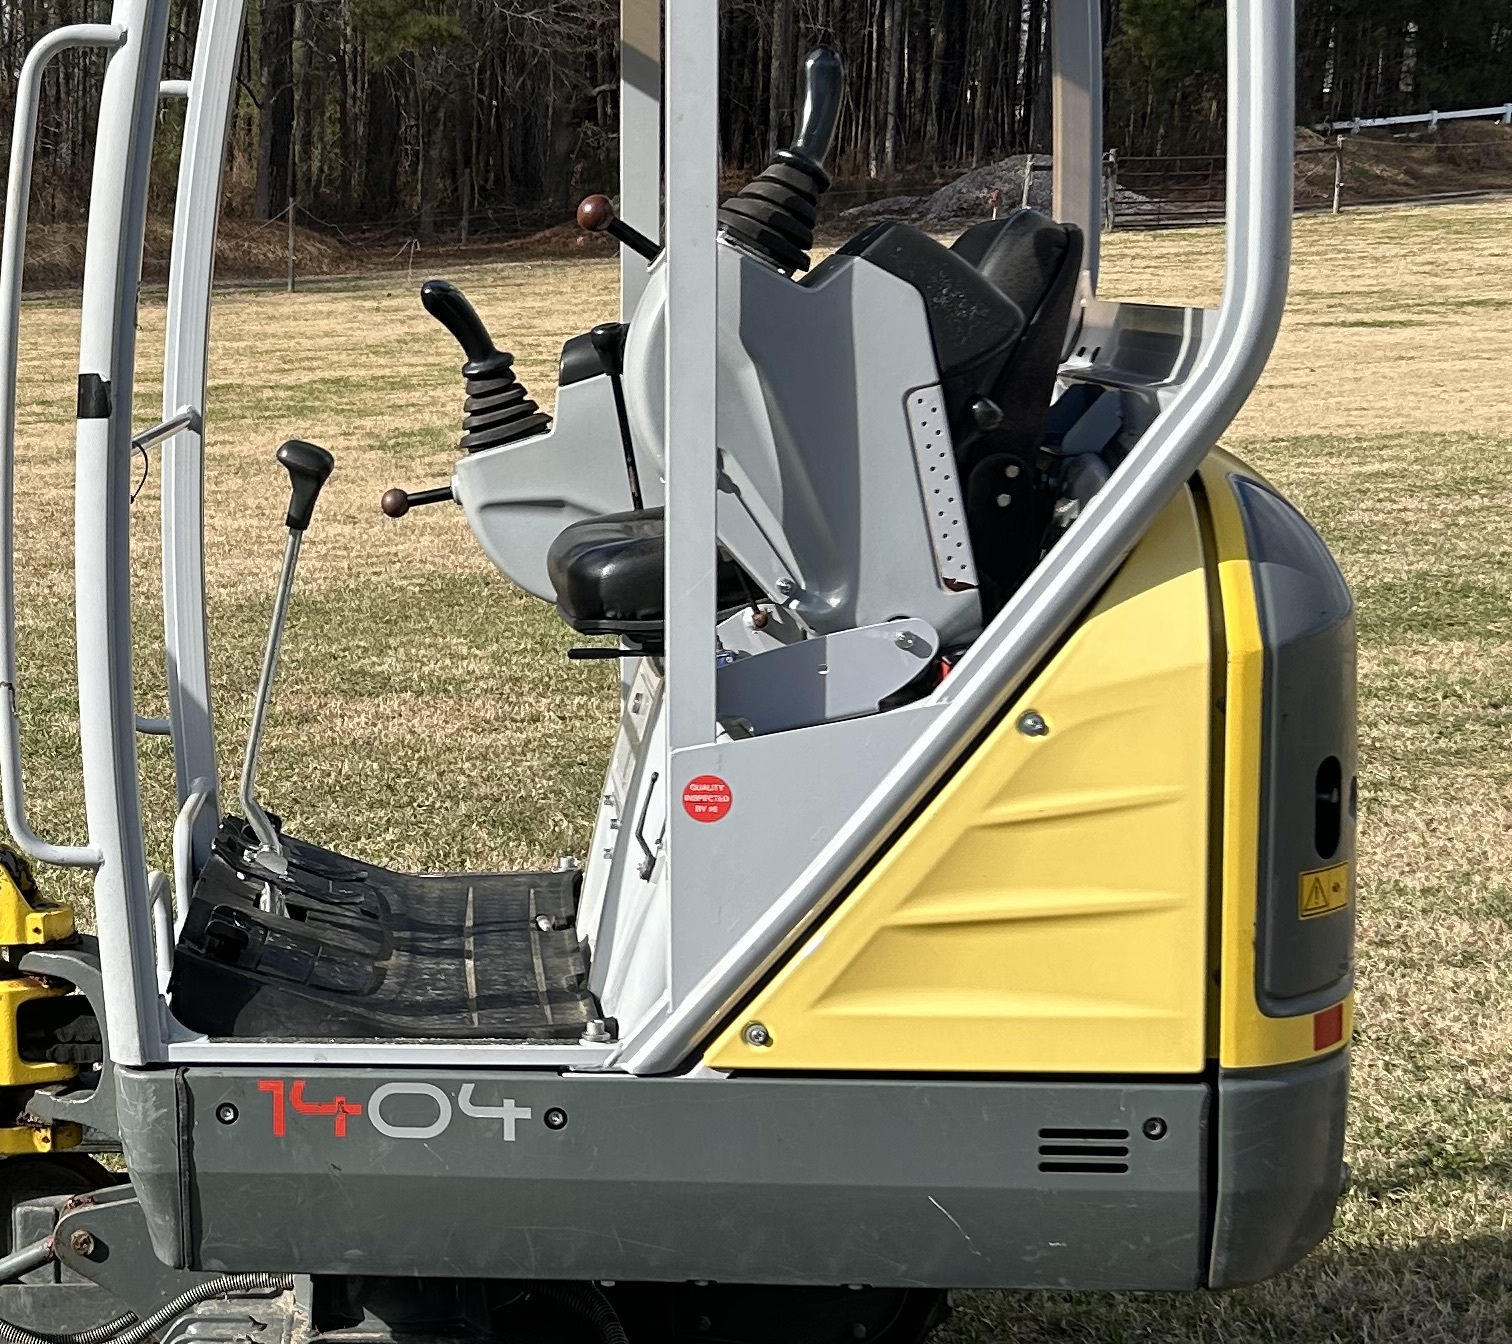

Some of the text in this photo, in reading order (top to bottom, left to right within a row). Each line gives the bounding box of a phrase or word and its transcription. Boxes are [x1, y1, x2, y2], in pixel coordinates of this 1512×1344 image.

[689, 783, 726, 792] QUALITY
[683, 794, 730, 803] INSPECTED
[694, 805, 708, 813] BY
[257, 1079, 532, 1142] 1404
